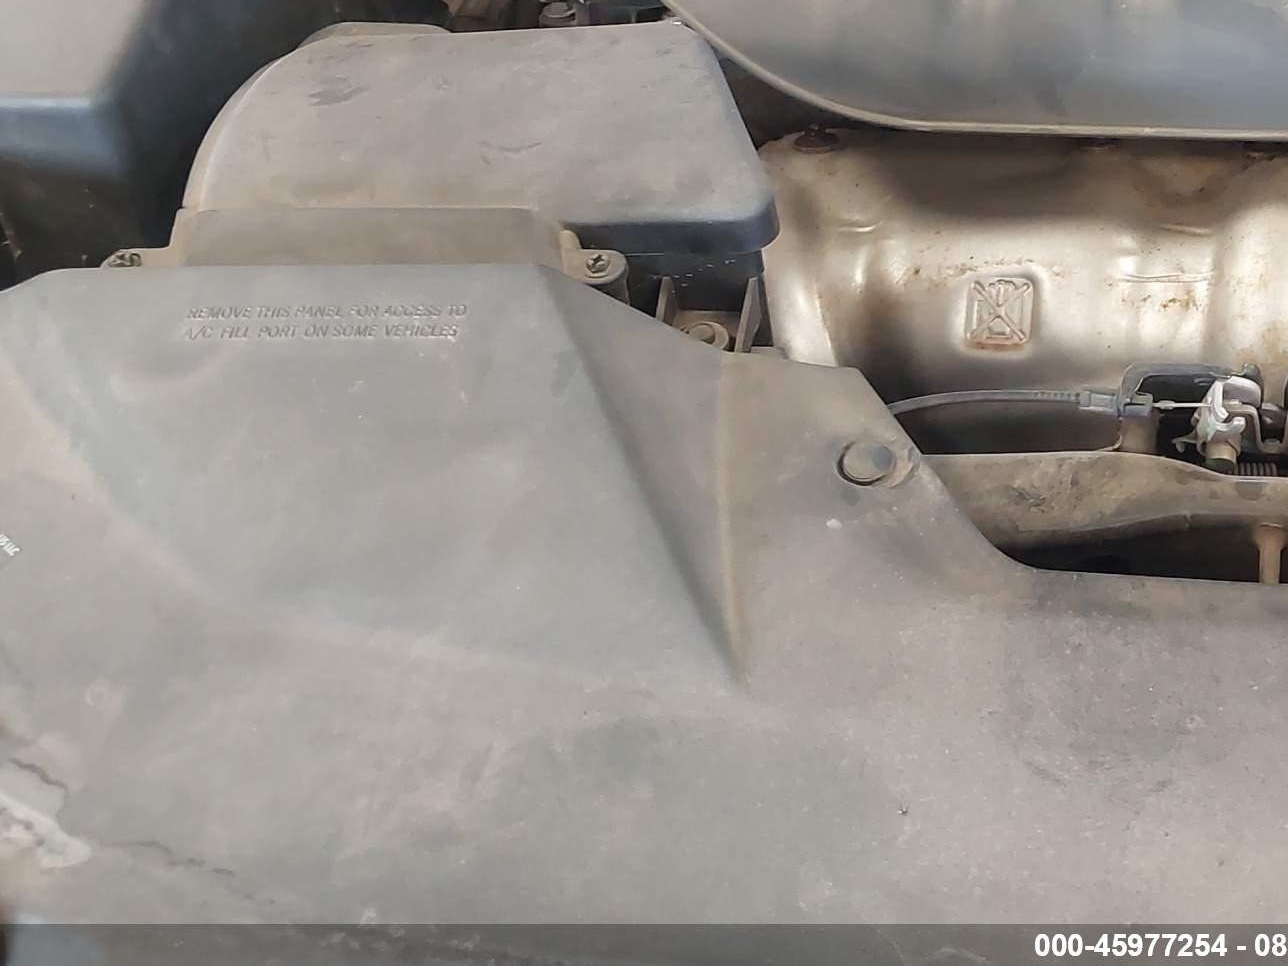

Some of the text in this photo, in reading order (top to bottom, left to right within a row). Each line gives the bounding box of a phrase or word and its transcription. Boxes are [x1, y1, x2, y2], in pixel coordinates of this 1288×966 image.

[186, 304, 468, 320] REMOVE THIS PANEL FOR ACCESS TO
[219, 325, 249, 339] FILL
[256, 325, 297, 338] PORT
[303, 324, 329, 338] ON
[332, 324, 378, 338] SOME
[384, 324, 458, 339] VEHICLES
